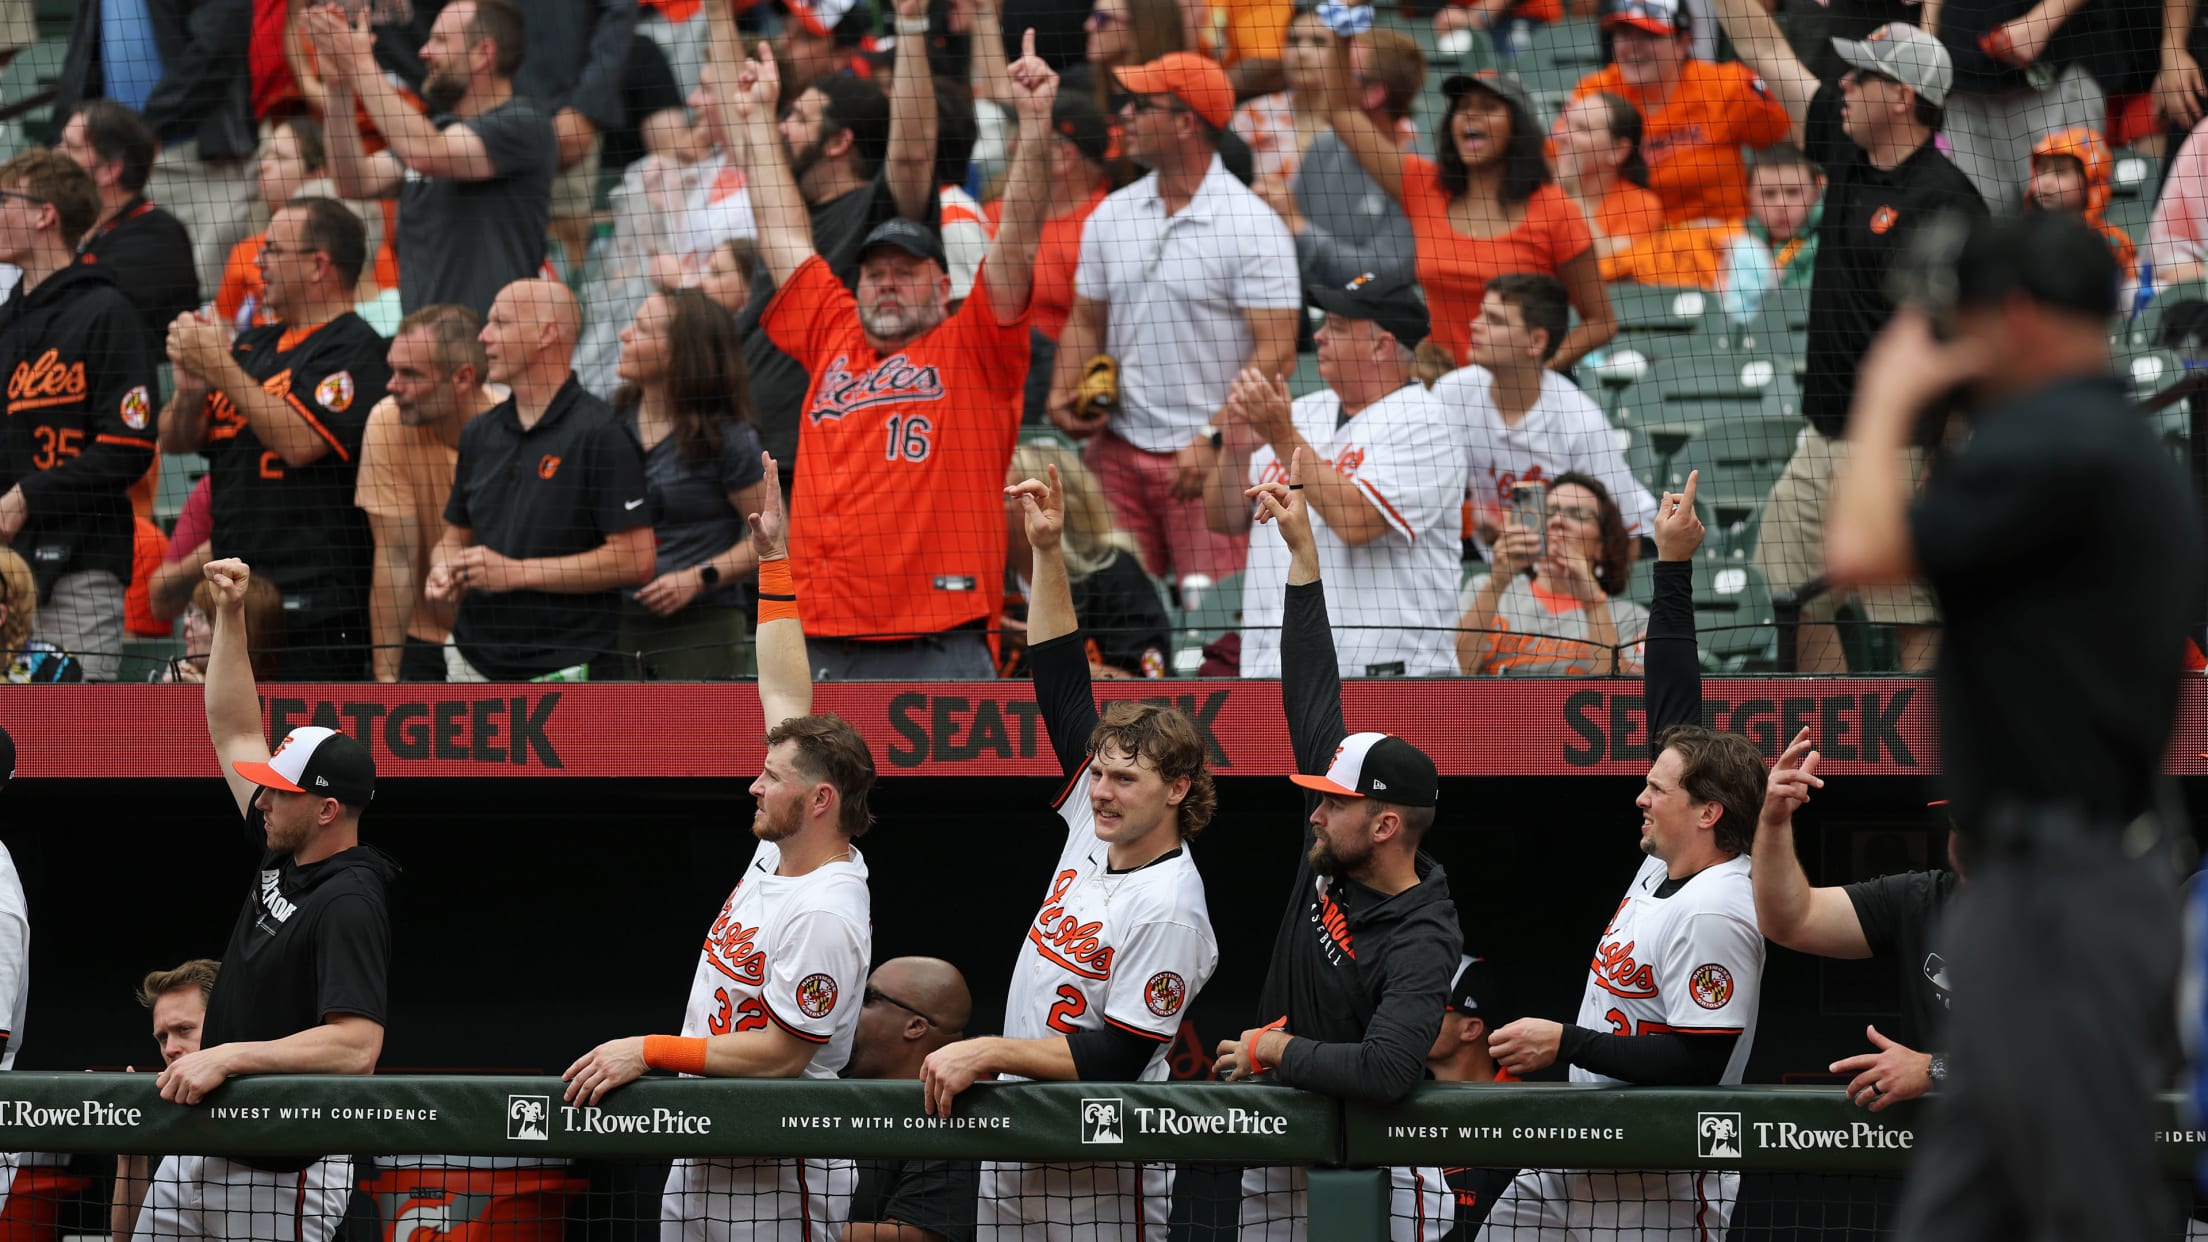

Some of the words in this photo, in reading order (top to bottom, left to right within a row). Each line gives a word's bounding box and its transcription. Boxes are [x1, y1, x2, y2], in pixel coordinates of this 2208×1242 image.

[33, 425, 85, 470] 35
[886, 414, 932, 462] 16
[708, 986, 768, 1036] 32
[1046, 983, 1088, 1034] 2
[211, 1107, 271, 1119] INVEST
[279, 1107, 322, 1119] WITH
[331, 1107, 438, 1121] CONFIDENCE
[781, 1116, 842, 1128] INVEST
[850, 1116, 894, 1129] WITH
[903, 1116, 1011, 1129] CONFIDENCE
[1388, 1126, 1449, 1138] INVEST
[1458, 1126, 1502, 1139] WITH
[1512, 1126, 1624, 1140] CONFIDENCE
